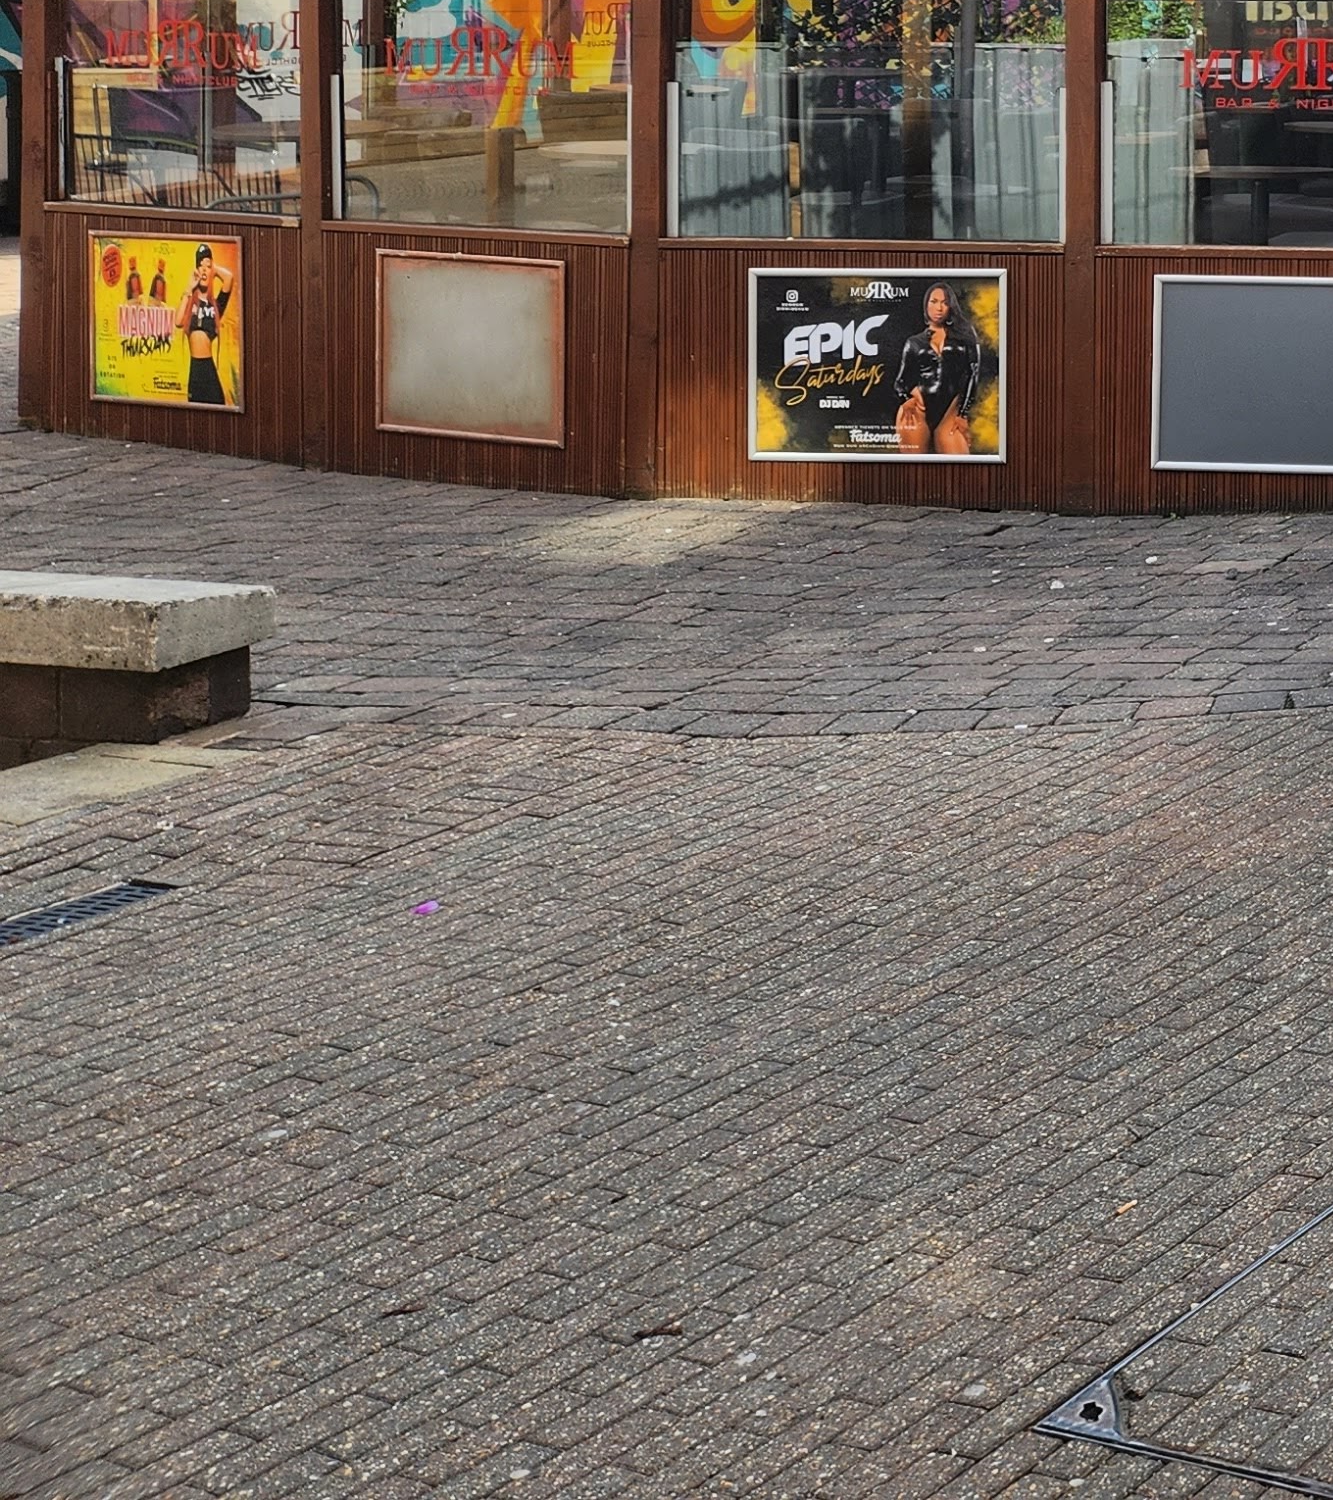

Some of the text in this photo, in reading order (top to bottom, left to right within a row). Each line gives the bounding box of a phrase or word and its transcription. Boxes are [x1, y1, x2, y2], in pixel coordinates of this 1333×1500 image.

[1215, 97, 1252, 109] BAR
[1267, 98, 1280, 110] &
[119, 305, 176, 340] MAGNUM
[784, 314, 890, 367] EPIC
[775, 355, 885, 406] Saturdays
[818, 399, 831, 409] DJ
[849, 429, 902, 443] Fatsoma
